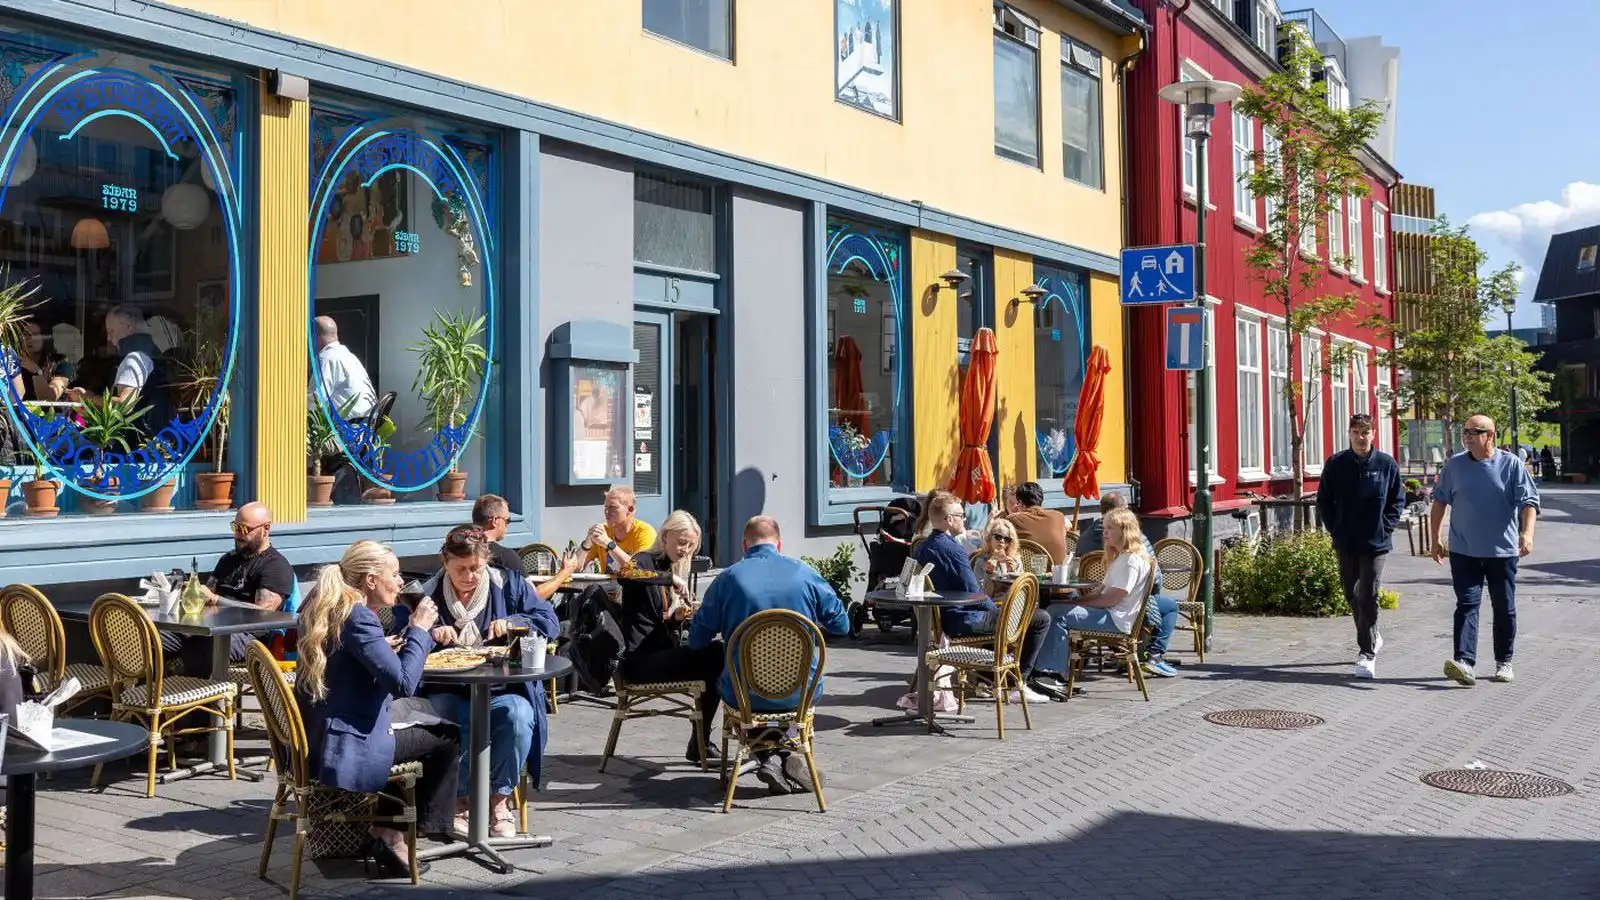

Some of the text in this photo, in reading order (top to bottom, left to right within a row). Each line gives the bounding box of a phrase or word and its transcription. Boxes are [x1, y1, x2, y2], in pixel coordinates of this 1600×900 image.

[102, 197, 137, 212] 1979
[394, 241, 420, 253] 1979
[664, 276, 681, 303] 15
